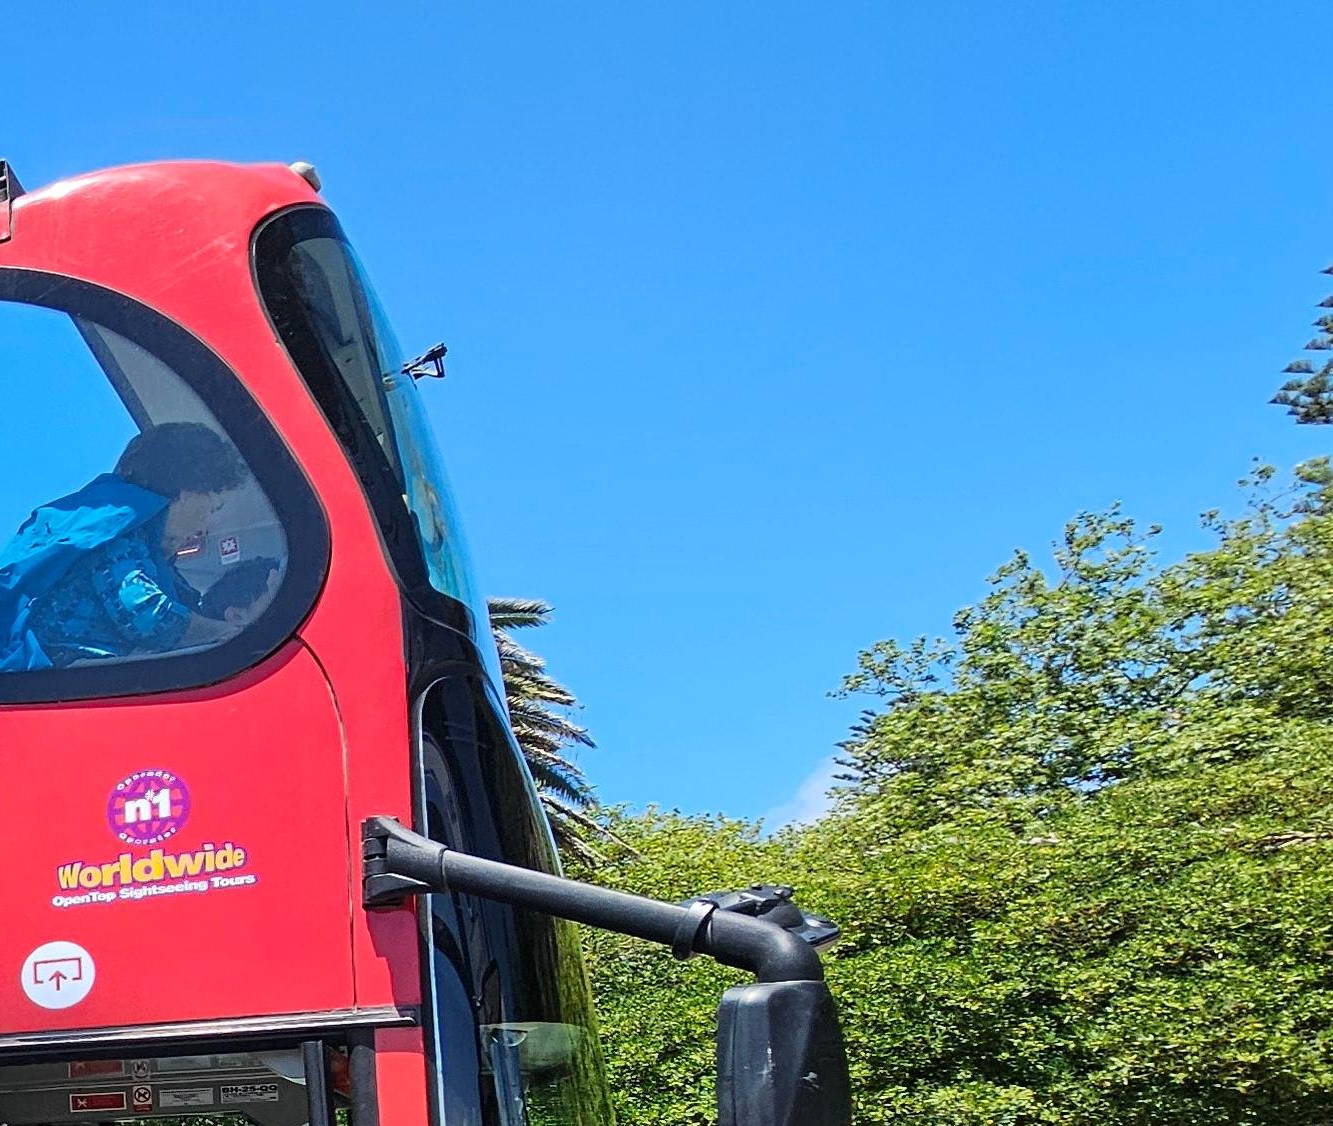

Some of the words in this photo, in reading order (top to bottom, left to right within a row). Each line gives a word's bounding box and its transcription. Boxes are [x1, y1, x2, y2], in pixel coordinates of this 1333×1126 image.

[57, 842, 246, 890] Worldwide
[52, 890, 116, 907] OpenTop
[119, 880, 208, 899] Sightseeing
[211, 875, 256, 888] Tours
